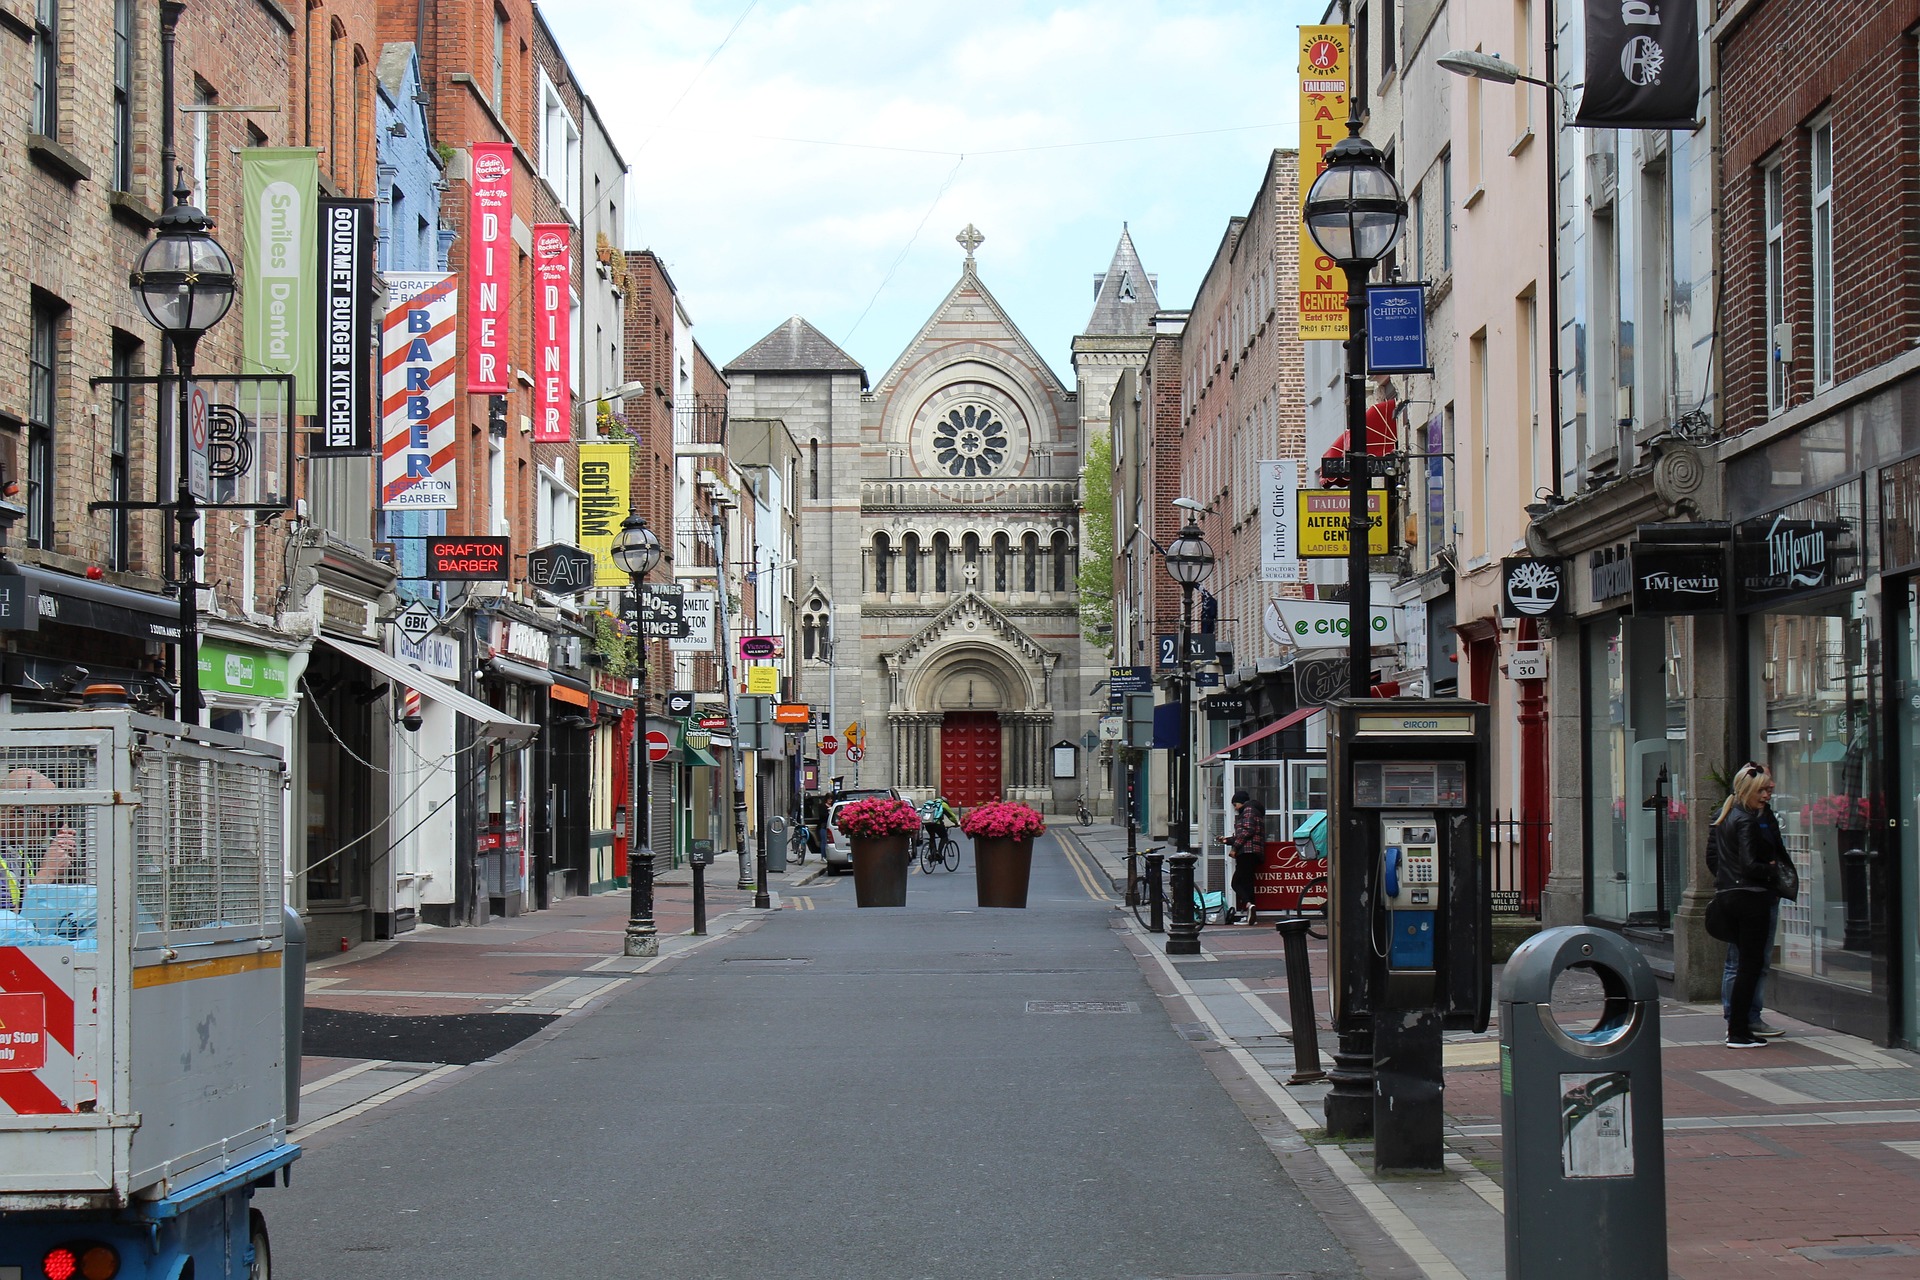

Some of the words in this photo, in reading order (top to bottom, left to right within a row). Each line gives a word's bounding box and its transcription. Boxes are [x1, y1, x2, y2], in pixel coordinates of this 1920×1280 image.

[1303, 34, 1345, 54] ALTERATION
[1308, 64, 1340, 76] CENTRE
[1304, 81, 1345, 92] TAILORING
[271, 194, 292, 269] Smiles
[333, 207, 352, 293] GOURMET
[390, 281, 398, 302] THE
[400, 281, 453, 290] GRAFTON
[401, 294, 447, 303] BARBER
[479, 213, 499, 383] DINER
[1303, 293, 1345, 310] CENTRE
[1305, 313, 1322, 321] Estd
[1324, 313, 1343, 321] 1975
[1373, 307, 1417, 316] CHIFFON
[270, 283, 291, 360] Dental
[332, 297, 351, 366] BURGER
[545, 285, 560, 433] DINER
[405, 309, 433, 478] BARBER
[331, 370, 350, 447] KITCHEN
[397, 481, 452, 491] GRAFTON
[400, 494, 447, 503] BARBER
[581, 461, 624, 536] GOTHAM
[1272, 484, 1285, 518] Clinic
[1273, 520, 1288, 561] Trinity
[433, 544, 503, 557] GRAFTON
[1307, 544, 1339, 552] LADIES
[1342, 544, 1349, 552] &
[438, 560, 498, 572] BARBER
[532, 554, 589, 586] EAT
[650, 584, 682, 595] WINES
[684, 599, 709, 611] SMETIC
[405, 615, 428, 630] GBK
[1519, 666, 1536, 676] 30
[1403, 720, 1438, 729] eircom
[820, 741, 838, 750] STOP
[1284, 872, 1305, 880] BAR
[1254, 885, 1285, 894] LDEST
[13, 1031, 39, 1044] Stop
